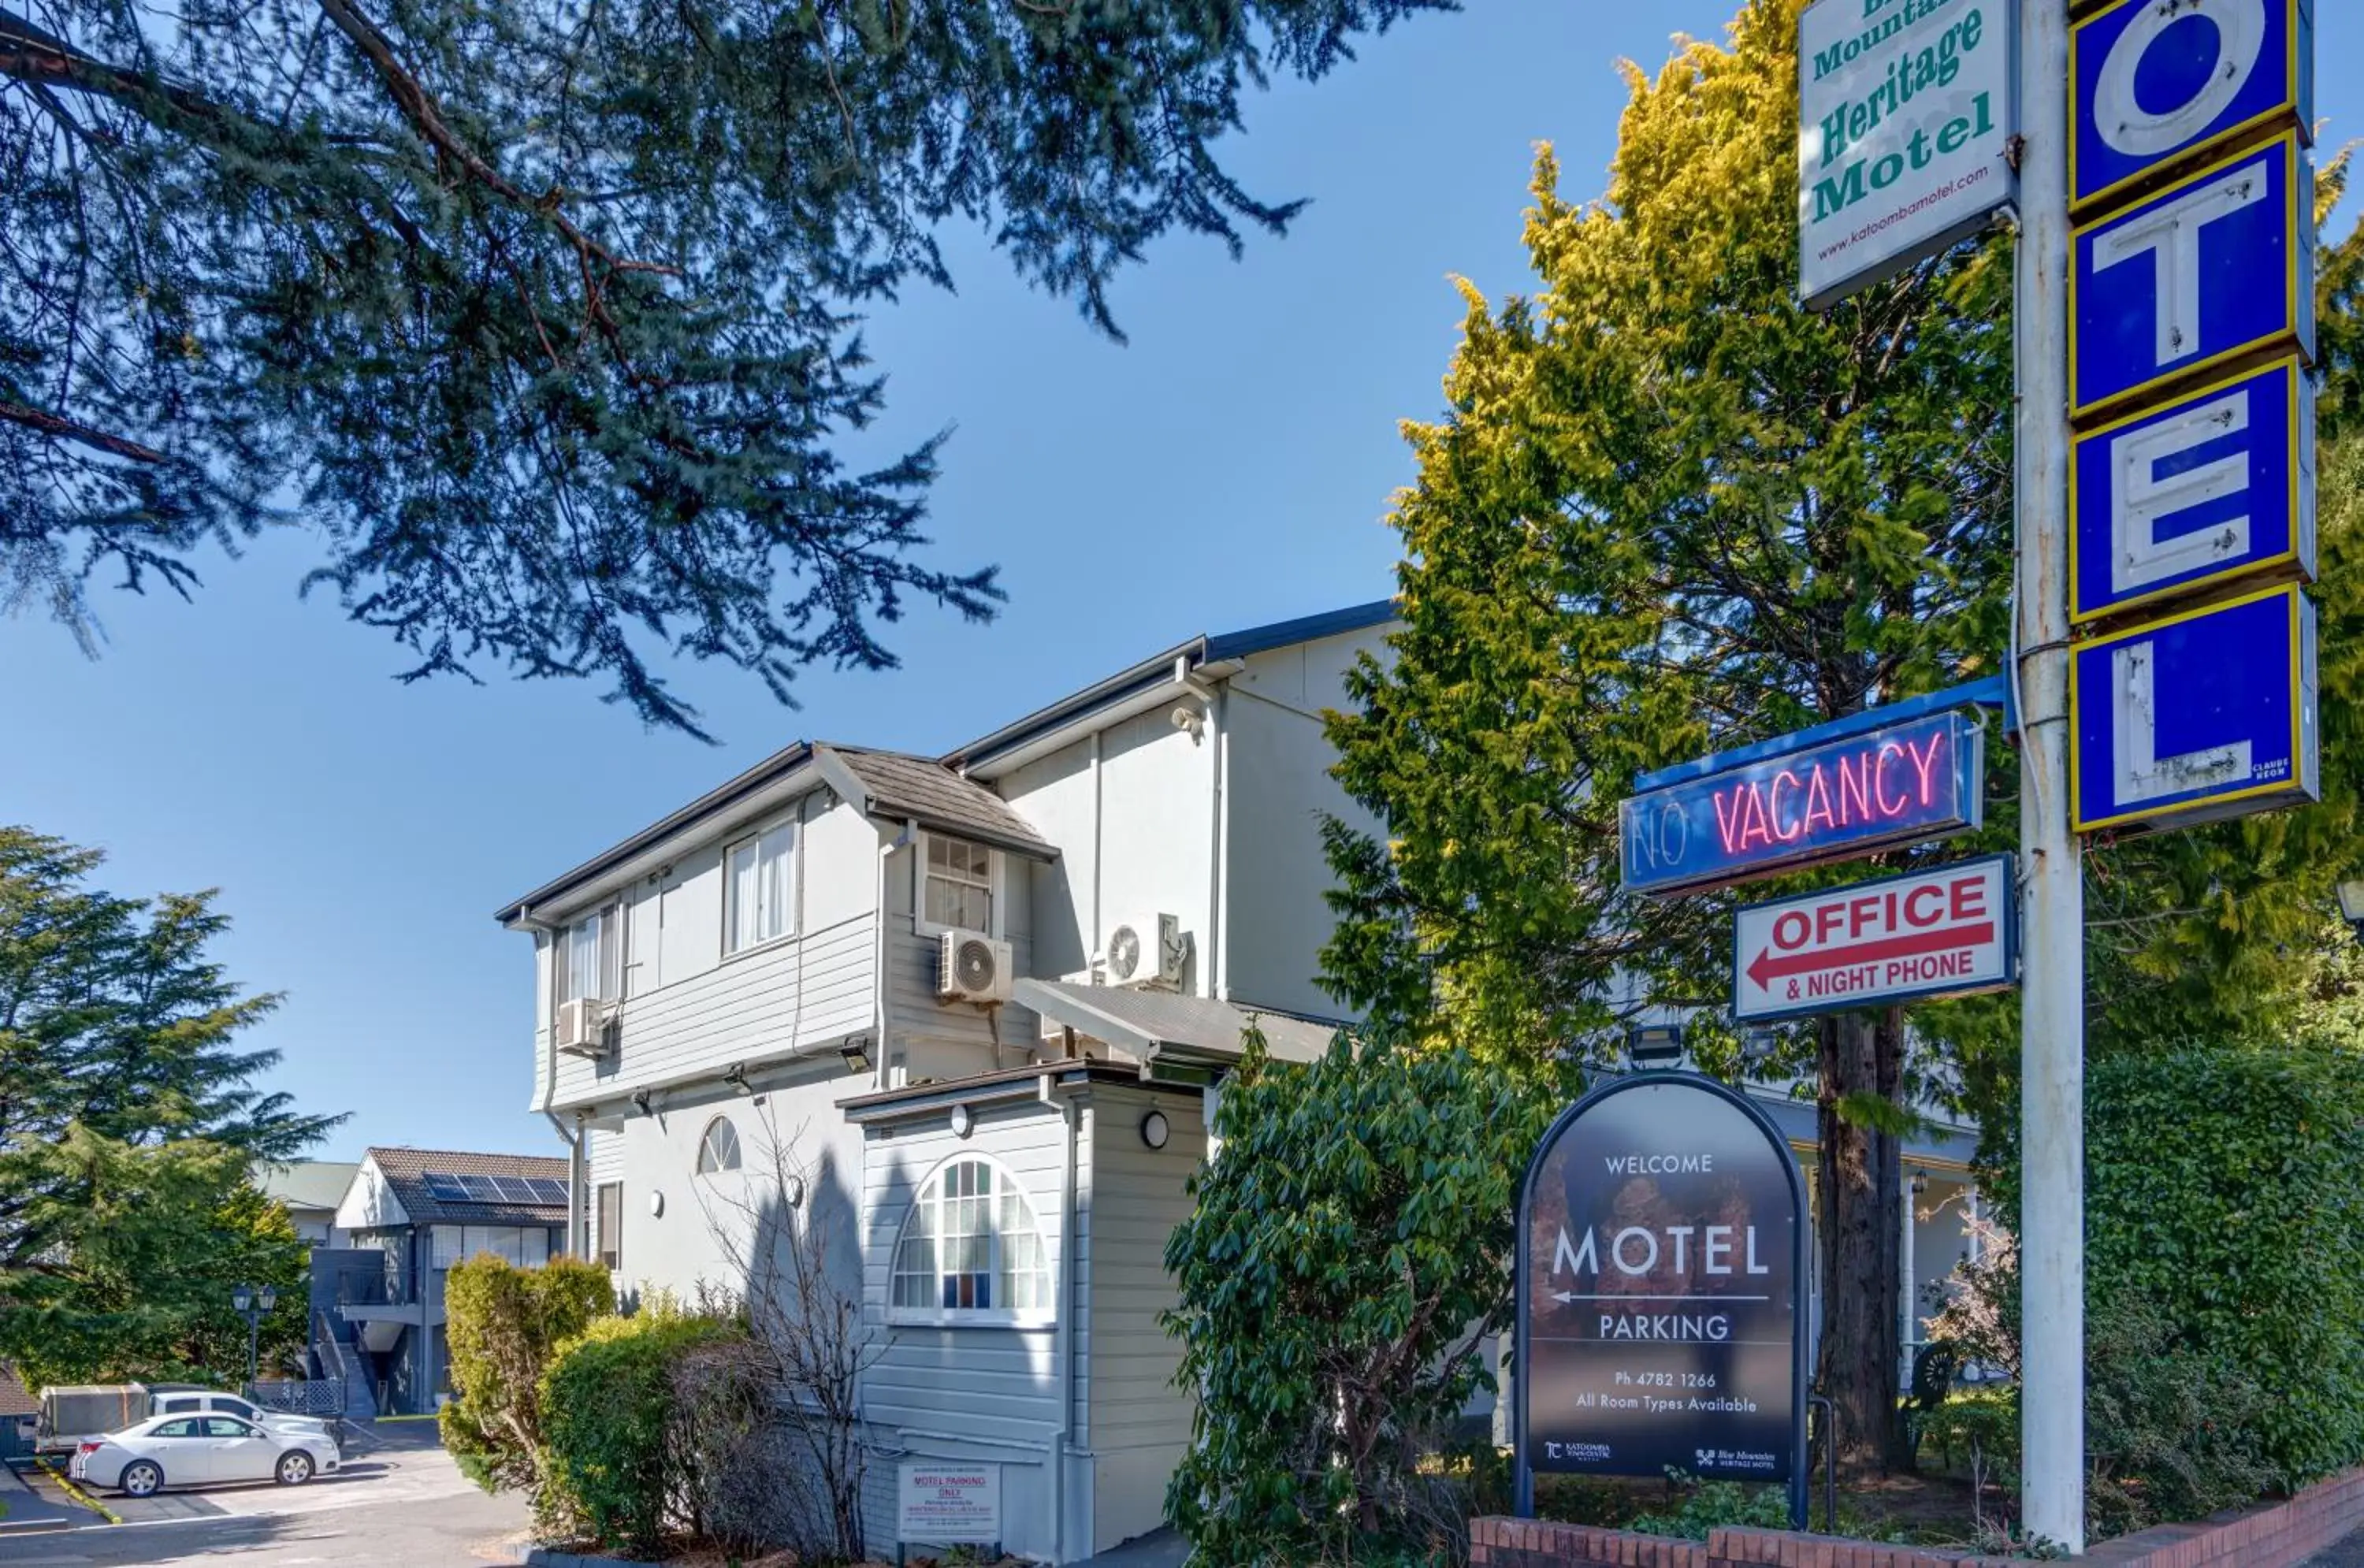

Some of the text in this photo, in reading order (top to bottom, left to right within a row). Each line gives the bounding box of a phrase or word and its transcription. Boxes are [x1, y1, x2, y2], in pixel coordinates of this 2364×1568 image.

[1813, 0, 1949, 82] Mounta
[1819, 8, 1983, 170] Heritage
[1812, 90, 1995, 225] Motel
[1817, 165, 1989, 262] www.katoombamotel.com
[2253, 756, 2289, 772] CLAUDE
[2256, 767, 2285, 781] NEON
[1631, 731, 1944, 871] NO VACANCY
[1772, 875, 1987, 951] OFFICE
[1786, 949, 1974, 1001] & NIGHT PHONE
[1605, 1154, 1712, 1176] WELCOME
[1552, 1225, 1769, 1276] MOTEL
[1600, 1314, 1728, 1341] PARKING
[1615, 1372, 1716, 1388] Ph 4782 1266
[1576, 1392, 1757, 1413] All Room Types Available
[1566, 1443, 1611, 1451] KATOOMBA
[915, 1476, 987, 1486] MOTEL PARKING
